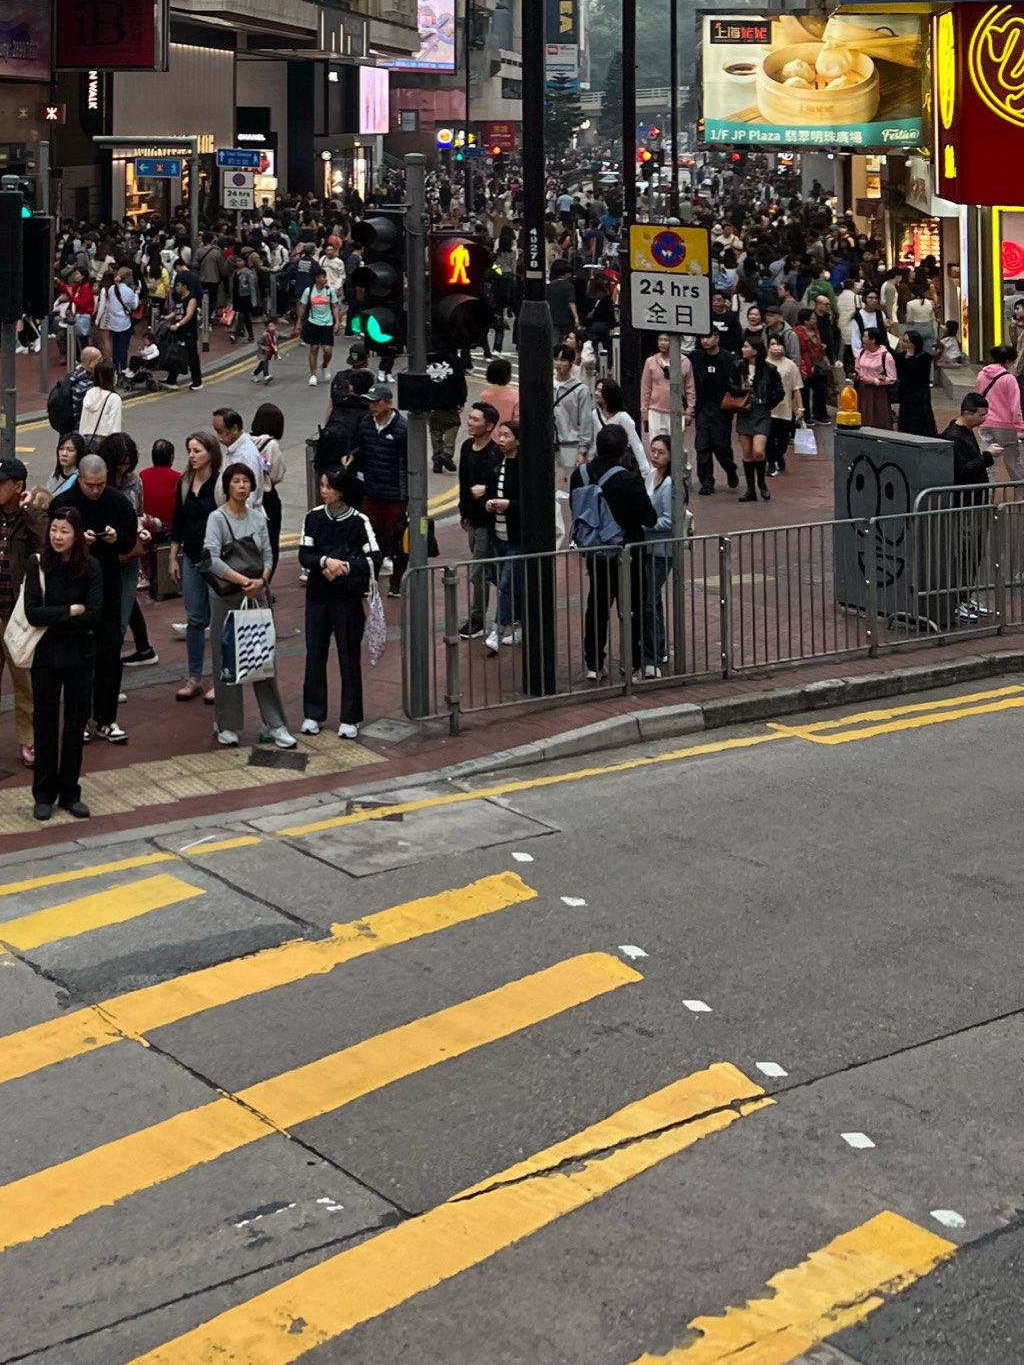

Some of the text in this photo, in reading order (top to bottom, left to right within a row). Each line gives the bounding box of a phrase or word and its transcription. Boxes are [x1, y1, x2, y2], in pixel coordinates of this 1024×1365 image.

[88, 80, 98, 109] WALK
[711, 130, 728, 141] 1/F
[732, 130, 746, 140] JP
[749, 130, 780, 141] Plaza
[640, 279, 700, 299] 24 hrs
[647, 302, 693, 326] 全日
